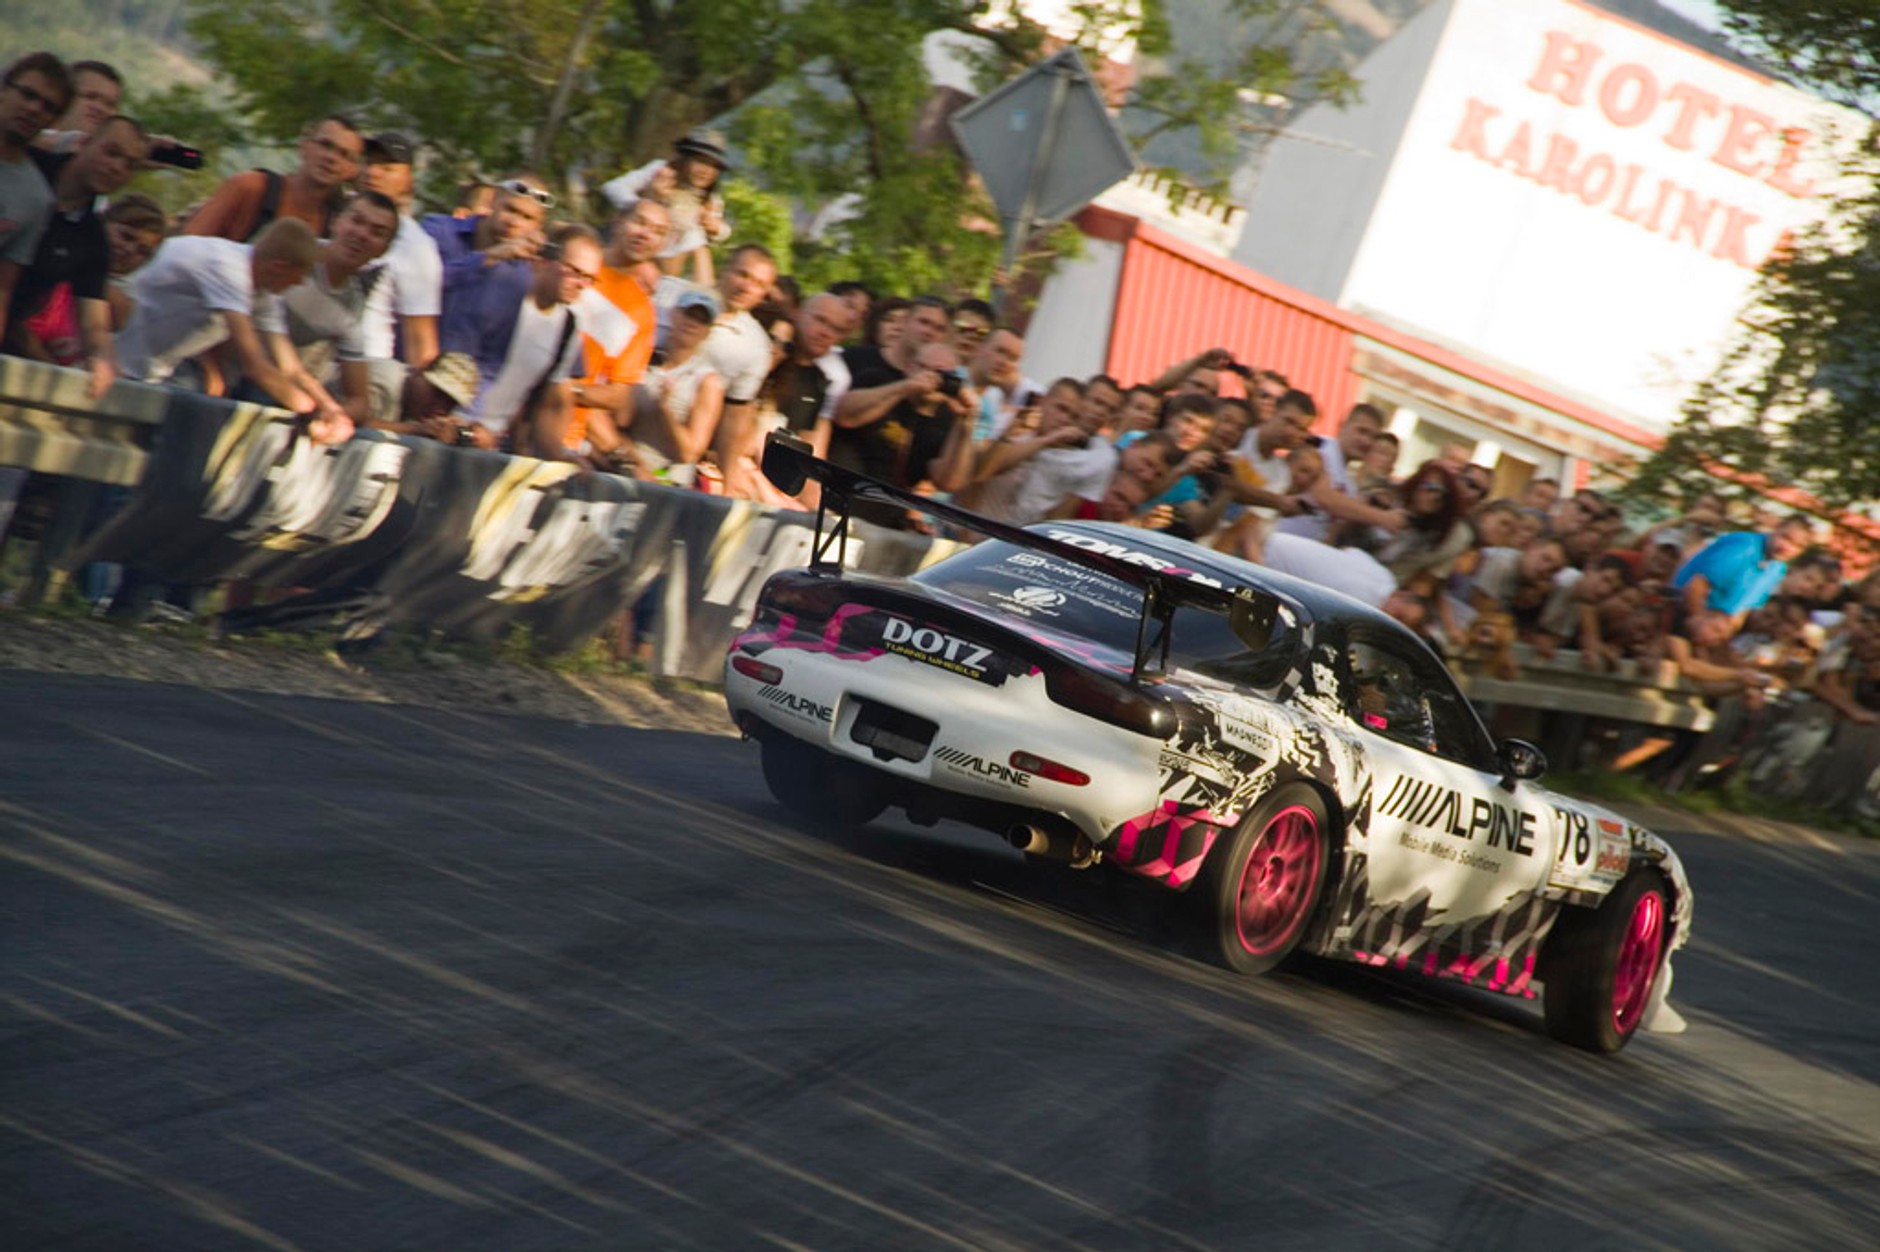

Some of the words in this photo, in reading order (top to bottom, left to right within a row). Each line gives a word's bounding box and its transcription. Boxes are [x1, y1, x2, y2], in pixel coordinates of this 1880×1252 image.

[1526, 29, 1816, 198] HOTEL
[882, 617, 993, 672] DOTZ
[885, 643, 926, 662] TUNING
[928, 656, 980, 679] WHEELS
[1459, 849, 1502, 875] Solutions
[1555, 808, 1591, 867] 78
